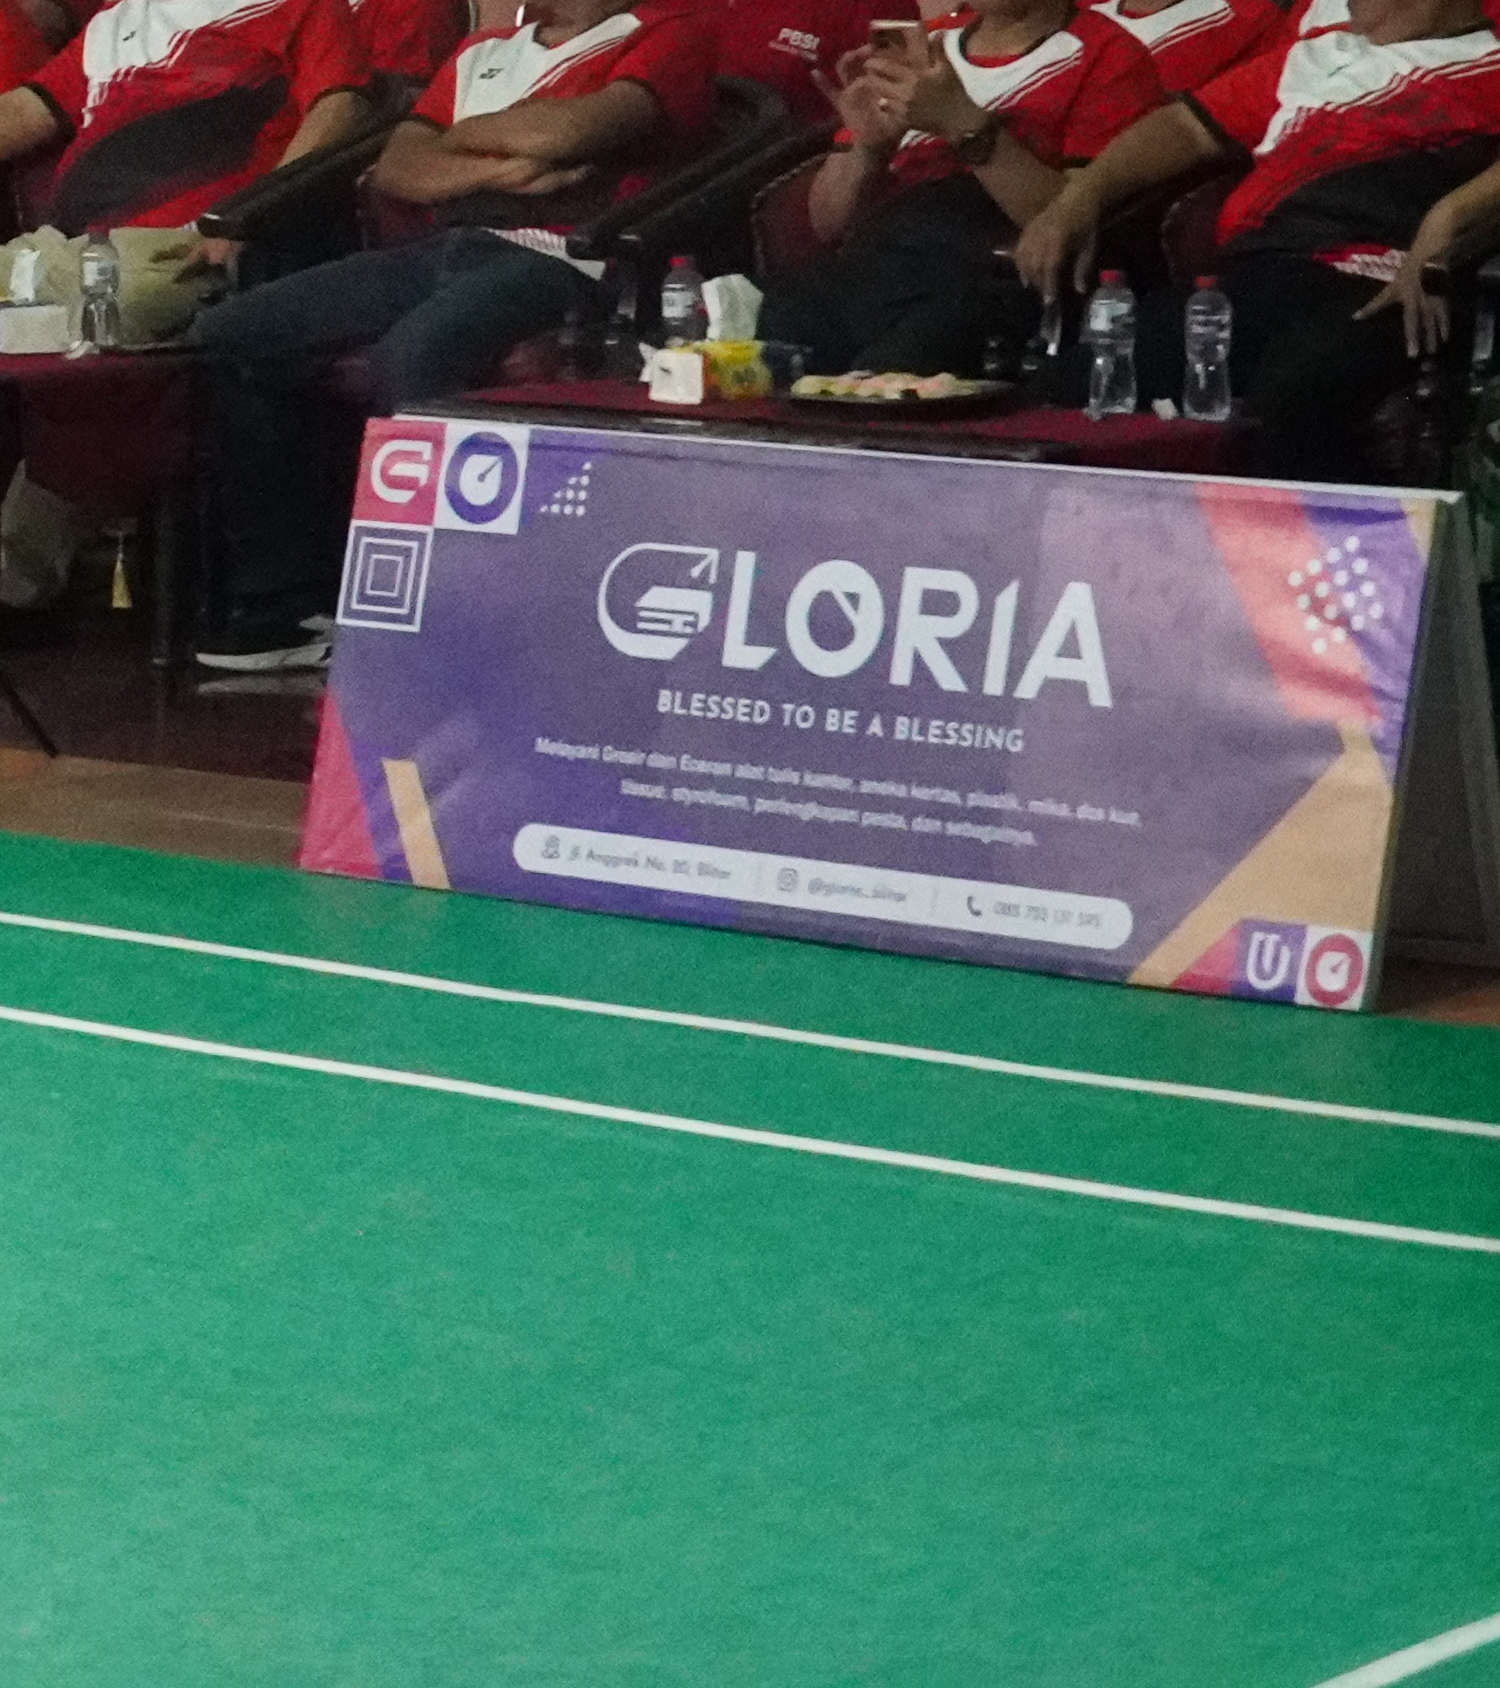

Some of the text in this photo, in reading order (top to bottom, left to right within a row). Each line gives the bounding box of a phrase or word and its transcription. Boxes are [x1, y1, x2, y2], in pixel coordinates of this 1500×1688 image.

[598, 542, 1114, 709] GLORIA
[657, 689, 1025, 753] BLESSED TO BE A BLESSING
